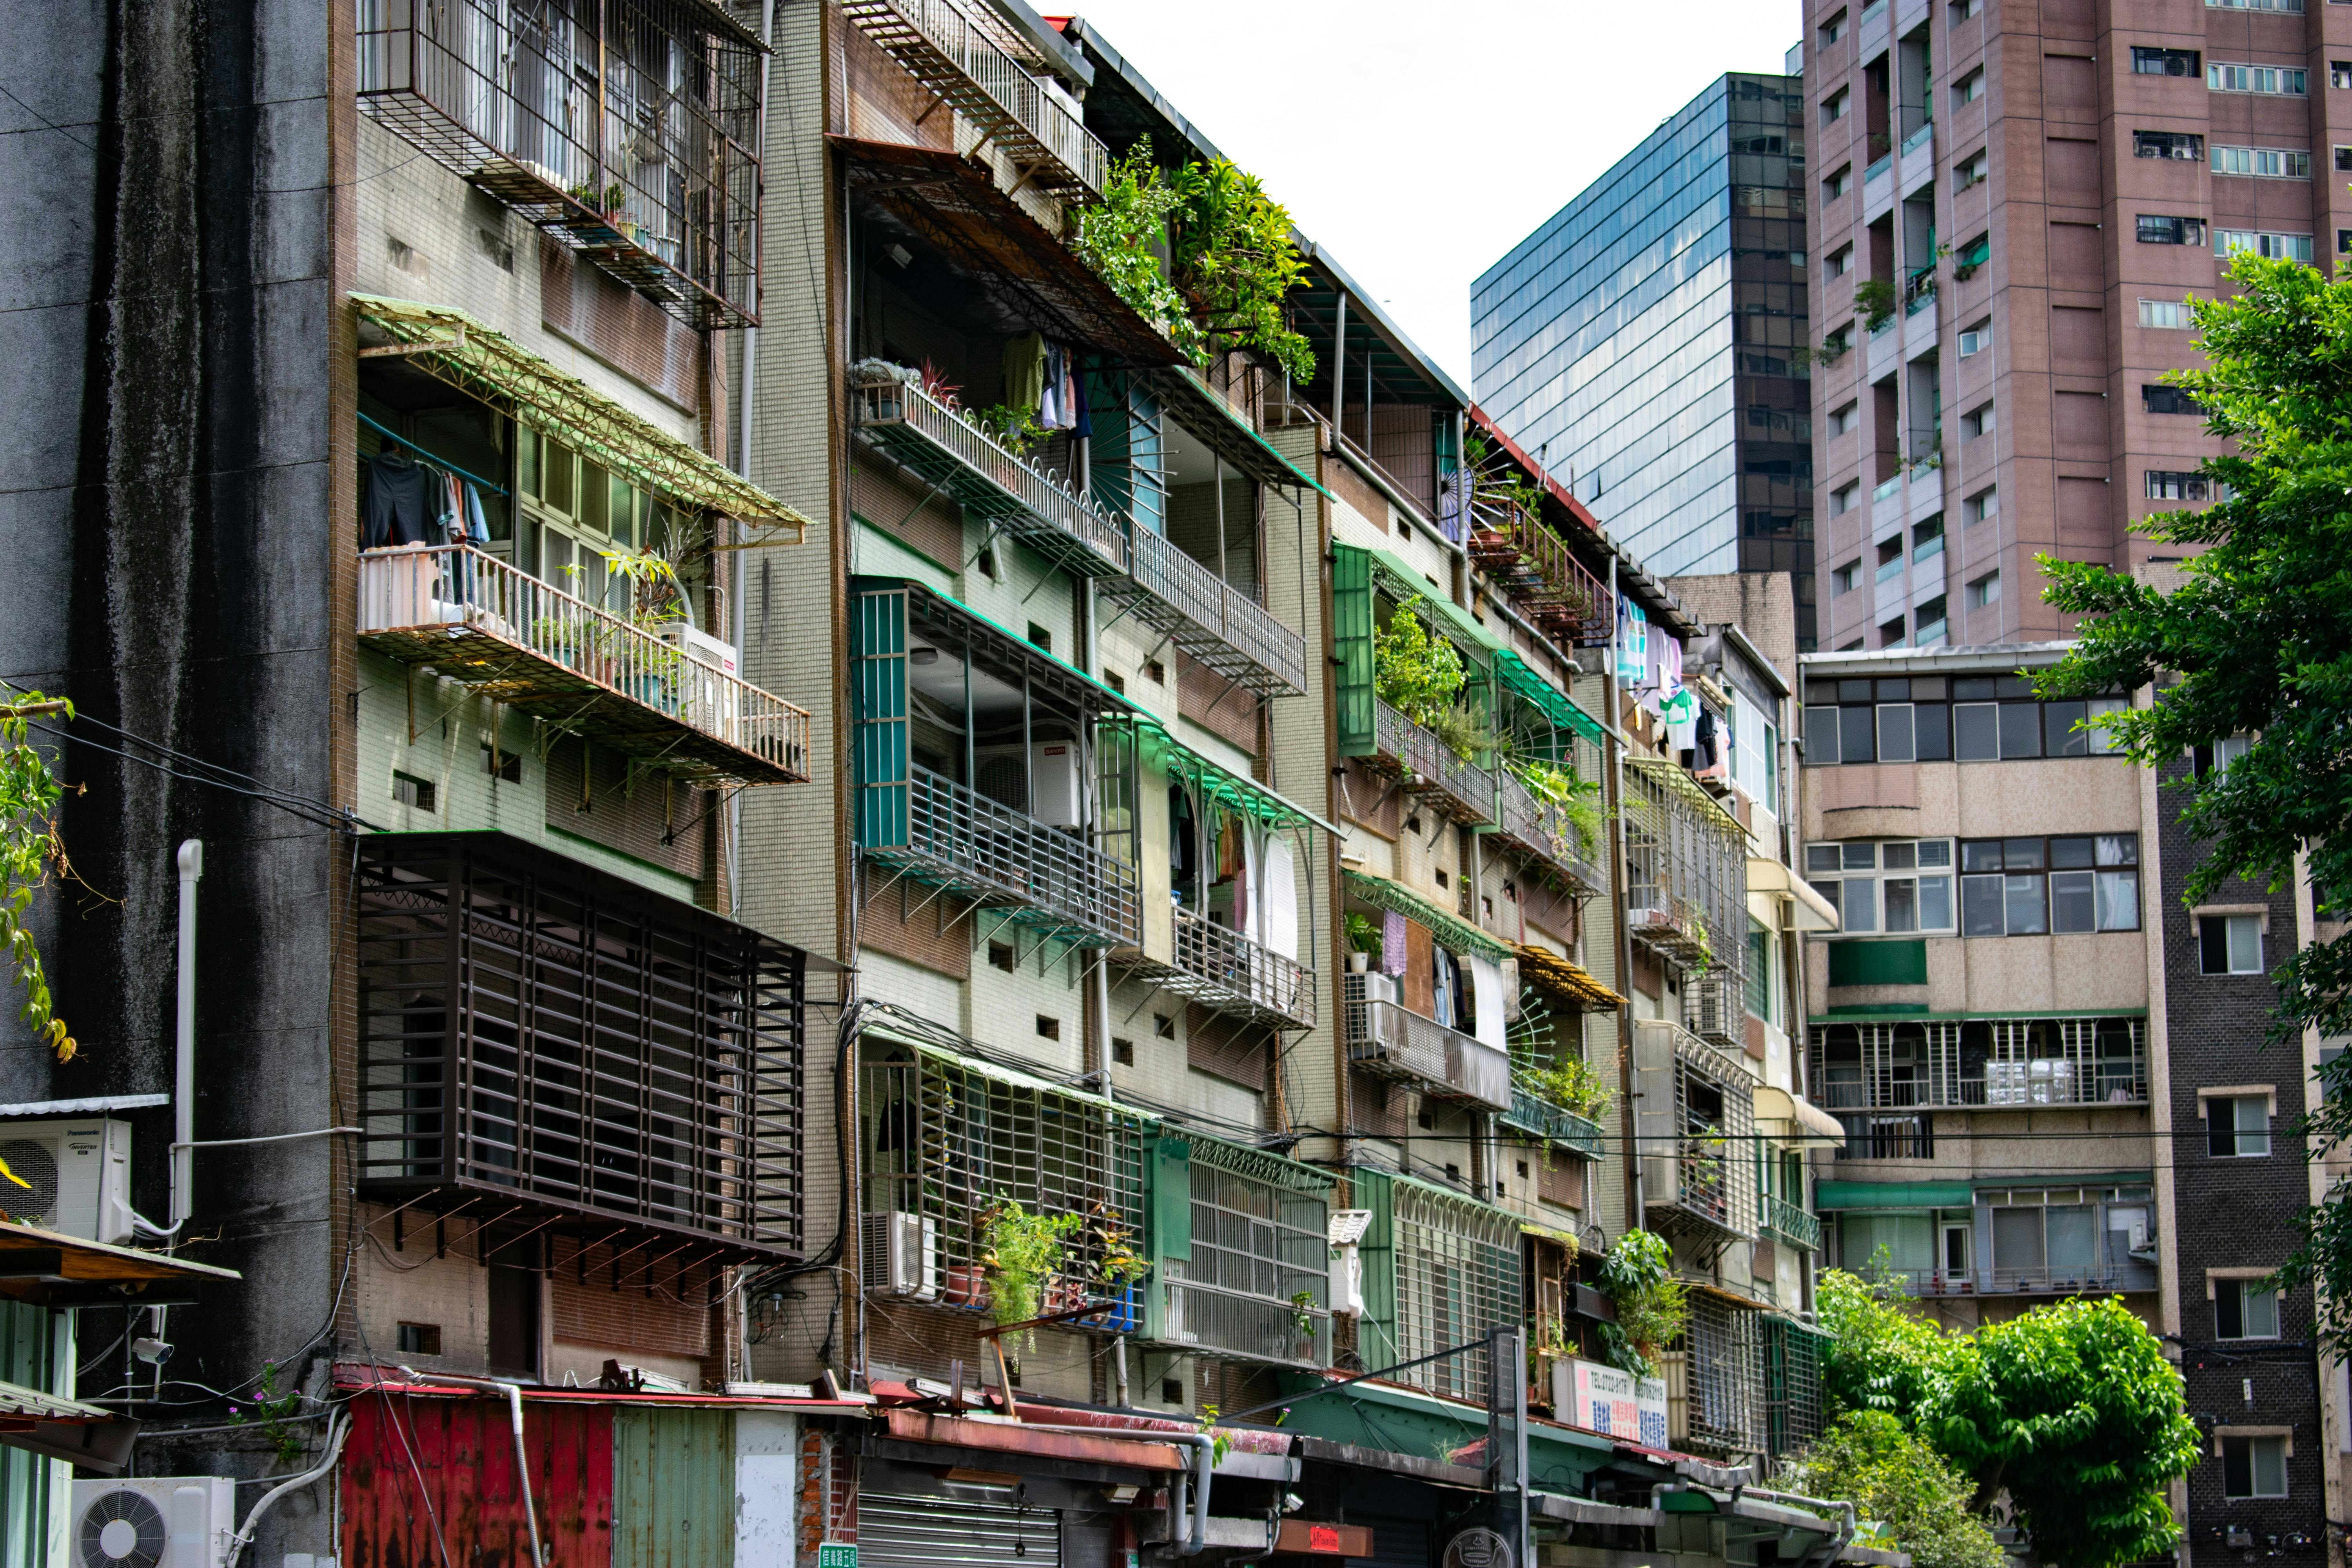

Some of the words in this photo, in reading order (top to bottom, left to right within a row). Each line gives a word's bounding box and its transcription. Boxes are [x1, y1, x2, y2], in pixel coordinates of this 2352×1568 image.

[1591, 1372, 1627, 1395] TEL:2722-9176
[822, 1549, 855, 1567] 信義路五段
